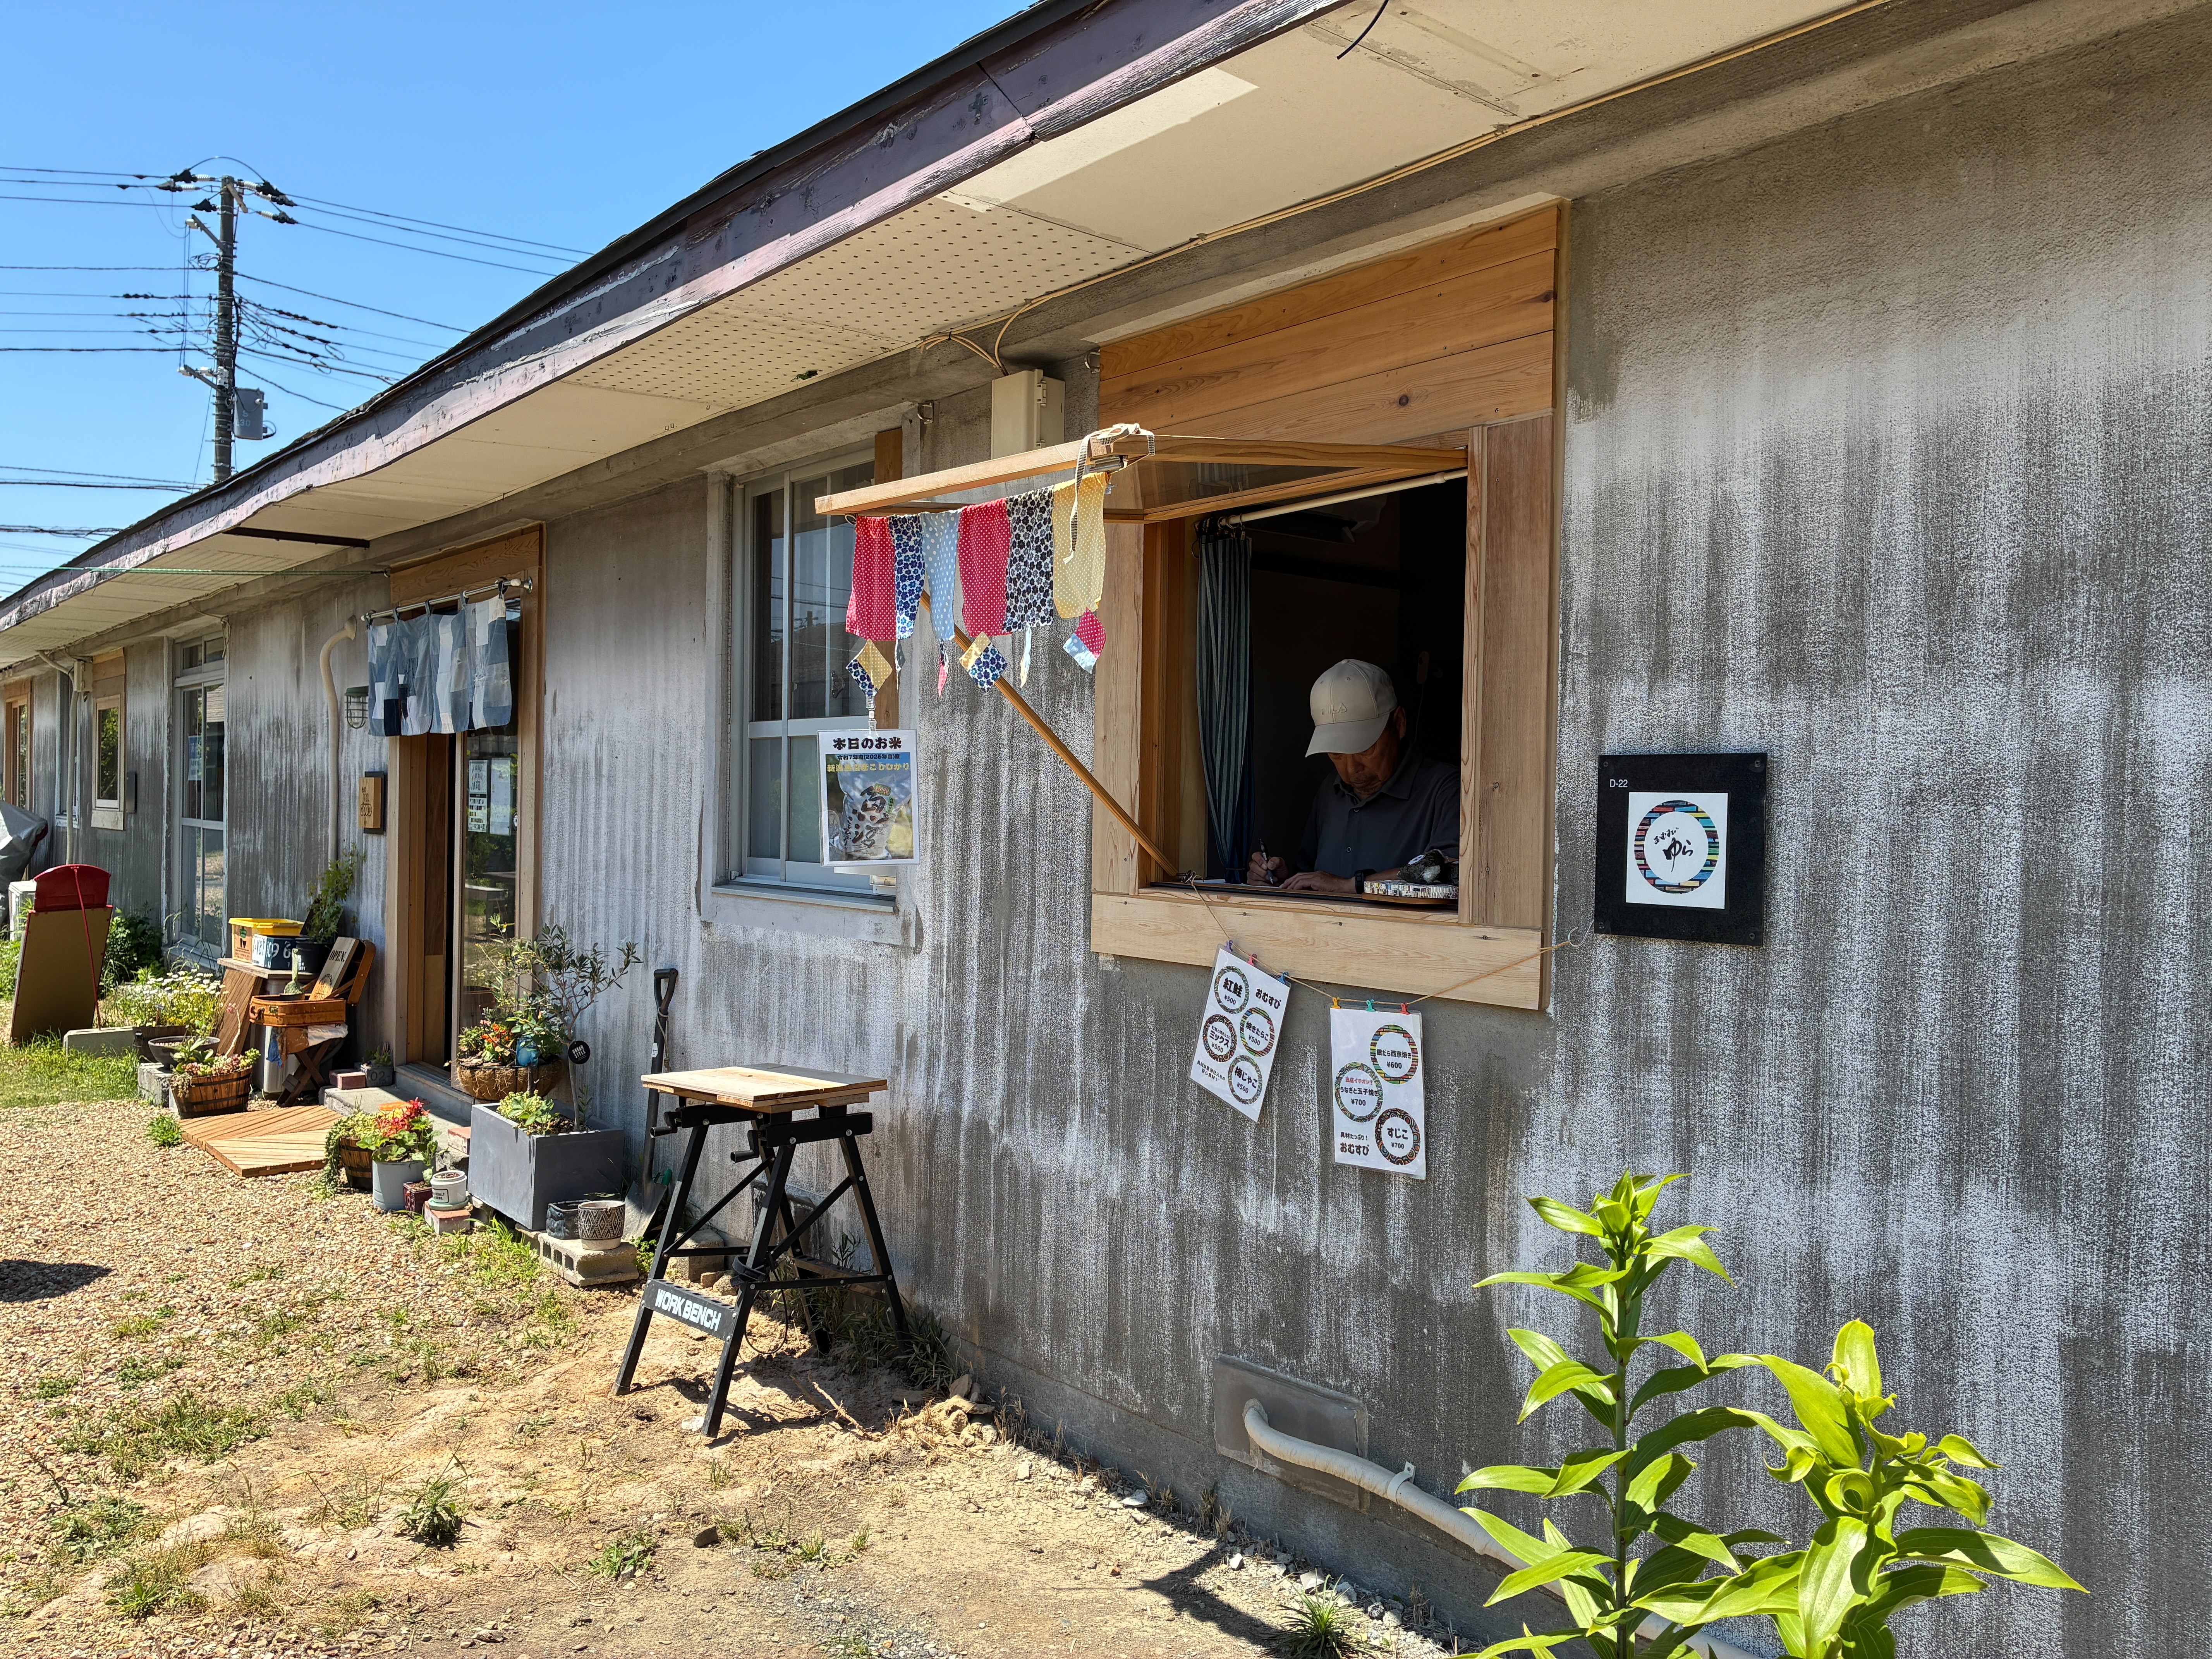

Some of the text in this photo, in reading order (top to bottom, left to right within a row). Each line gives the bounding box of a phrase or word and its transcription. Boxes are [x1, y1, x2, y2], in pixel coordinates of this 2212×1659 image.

[833, 737, 902, 750] 本日のお米
[1609, 779, 1628, 788] D-22
[1653, 827, 1679, 845] おむすび
[1662, 837, 1694, 873] ゆら
[1223, 977, 1243, 998] 紅鮭
[1224, 994, 1236, 1005] ¥500
[1255, 988, 1282, 1009] おむすび
[1245, 1020, 1269, 1041] 焼きたらこ
[1209, 1030, 1230, 1048] ミックス
[1249, 1034, 1261, 1046] ¥500
[1211, 1042, 1224, 1053] ¥500
[1377, 1049, 1412, 1059] 銀だら西京焼き
[1387, 1061, 1402, 1069] ¥600
[1235, 1066, 1258, 1089] 梅じゃこ
[1237, 1082, 1249, 1094] ¥500
[1340, 1086, 1379, 1097] うなぎと玉子焼き
[1387, 1127, 1408, 1140] すじこ
[1340, 1142, 1370, 1156] おむすび
[655, 1288, 722, 1332] WORK BENCH
